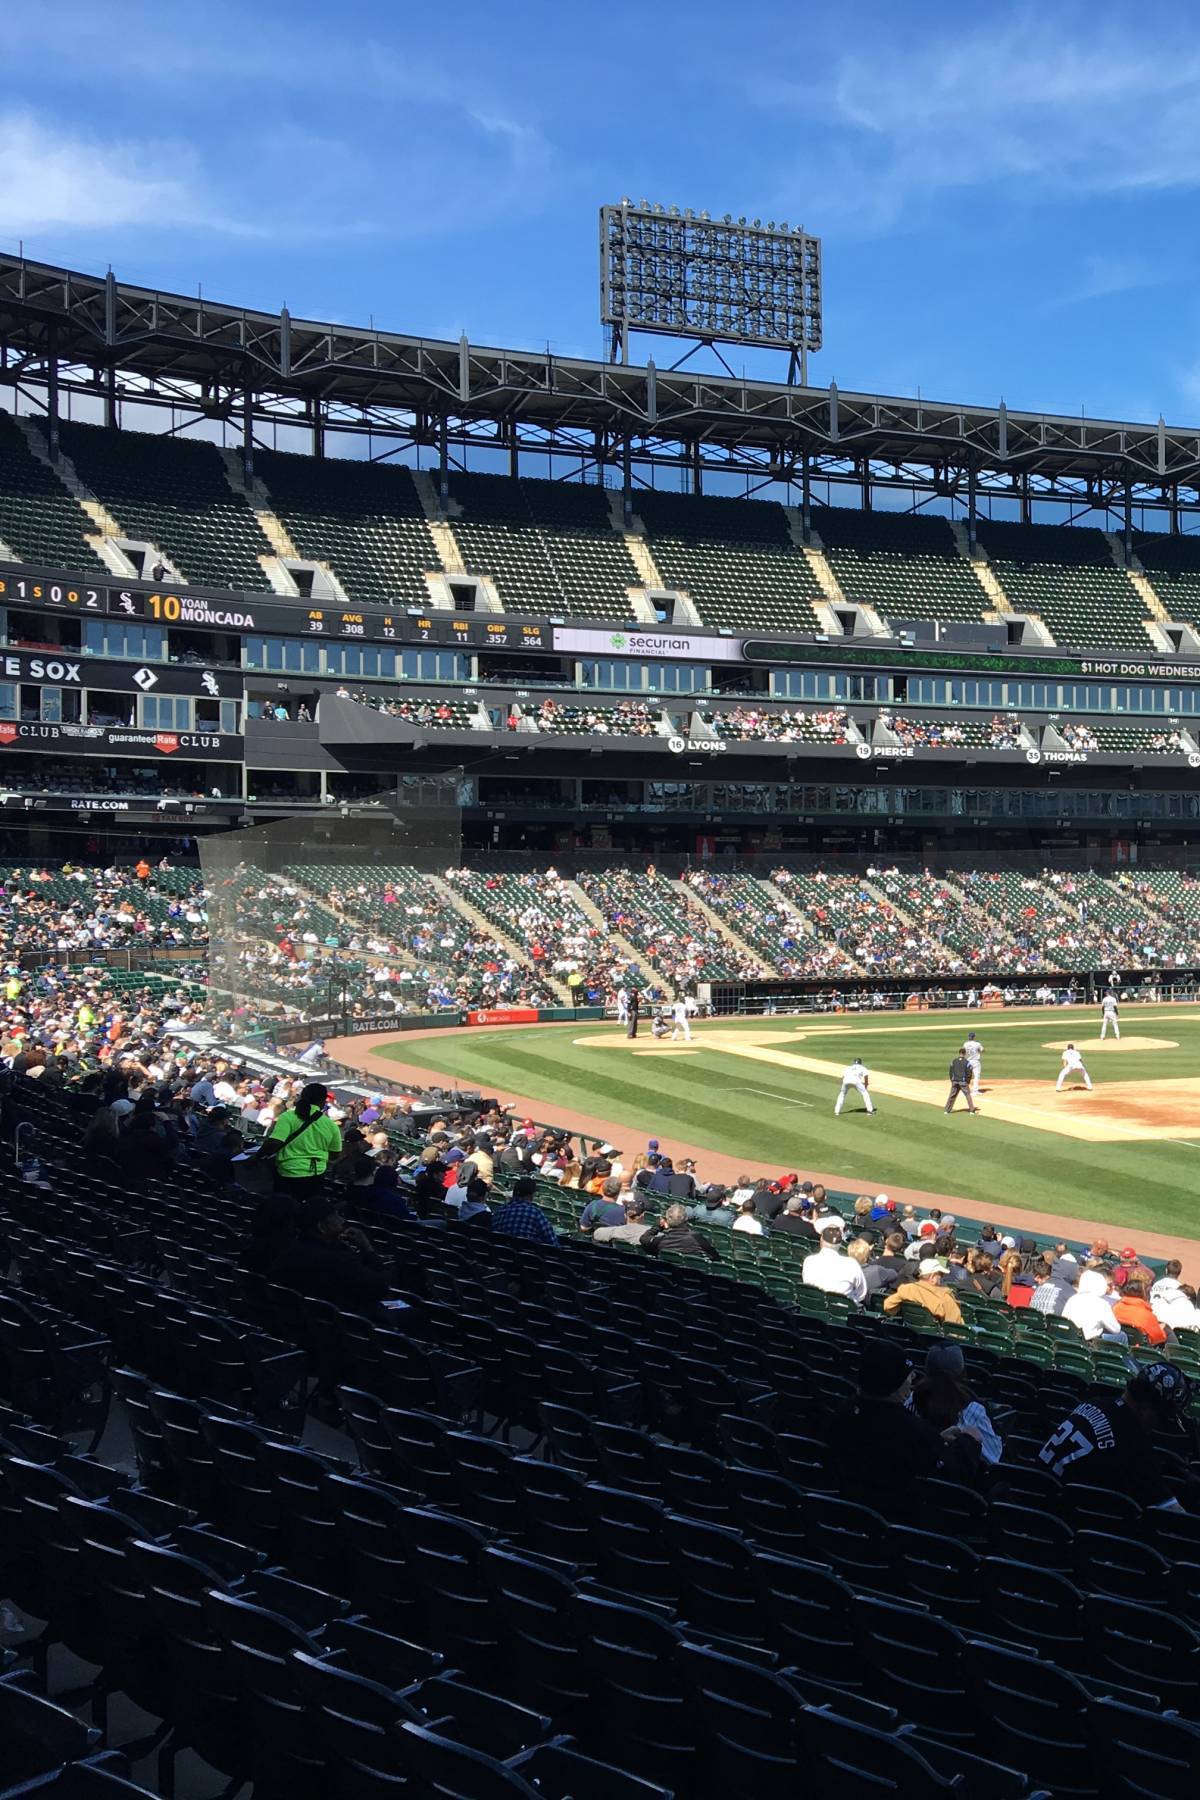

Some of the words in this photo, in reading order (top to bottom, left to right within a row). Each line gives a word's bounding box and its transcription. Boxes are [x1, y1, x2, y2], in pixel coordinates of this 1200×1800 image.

[17, 582, 25, 597] 1
[51, 586, 62, 602] 0
[86, 591, 98, 607] 2
[149, 595, 180, 620] 10
[180, 598, 208, 609] YOAN
[181, 608, 255, 627] MONCADA
[308, 611, 322, 619] AB
[342, 614, 363, 623] AVG
[310, 621, 323, 631] 39
[342, 624, 364, 634] .308
[418, 620, 431, 628] HR
[453, 622, 469, 630] RBI
[383, 628, 395, 637] 12
[421, 630, 428, 639] 2
[522, 627, 540, 635] SLG
[456, 632, 468, 641] 11
[486, 634, 507, 644] .357
[521, 636, 542, 646] .564
[629, 637, 690, 650] securian
[30, 659, 81, 682] SOX
[1081, 662, 1092, 673] $1
[1095, 663, 1118, 674] HOT
[1120, 664, 1145, 675] DOG
[19, 725, 60, 738] CLUB
[108, 733, 157, 744] guaranteed
[157, 735, 177, 744] Rate
[180, 736, 220, 748] CLUB
[671, 740, 682, 749] 16
[688, 739, 727, 751] LYONS
[858, 747, 869, 756] 19
[874, 747, 914, 757] PIERCE
[1028, 751, 1039, 760] 35
[1043, 752, 1088, 761] THOMAS
[1190, 756, 1200, 764] 56
[71, 800, 129, 810] RATE.COM
[352, 1020, 398, 1032] RATE.COM
[1038, 1419, 1095, 1477] 27
